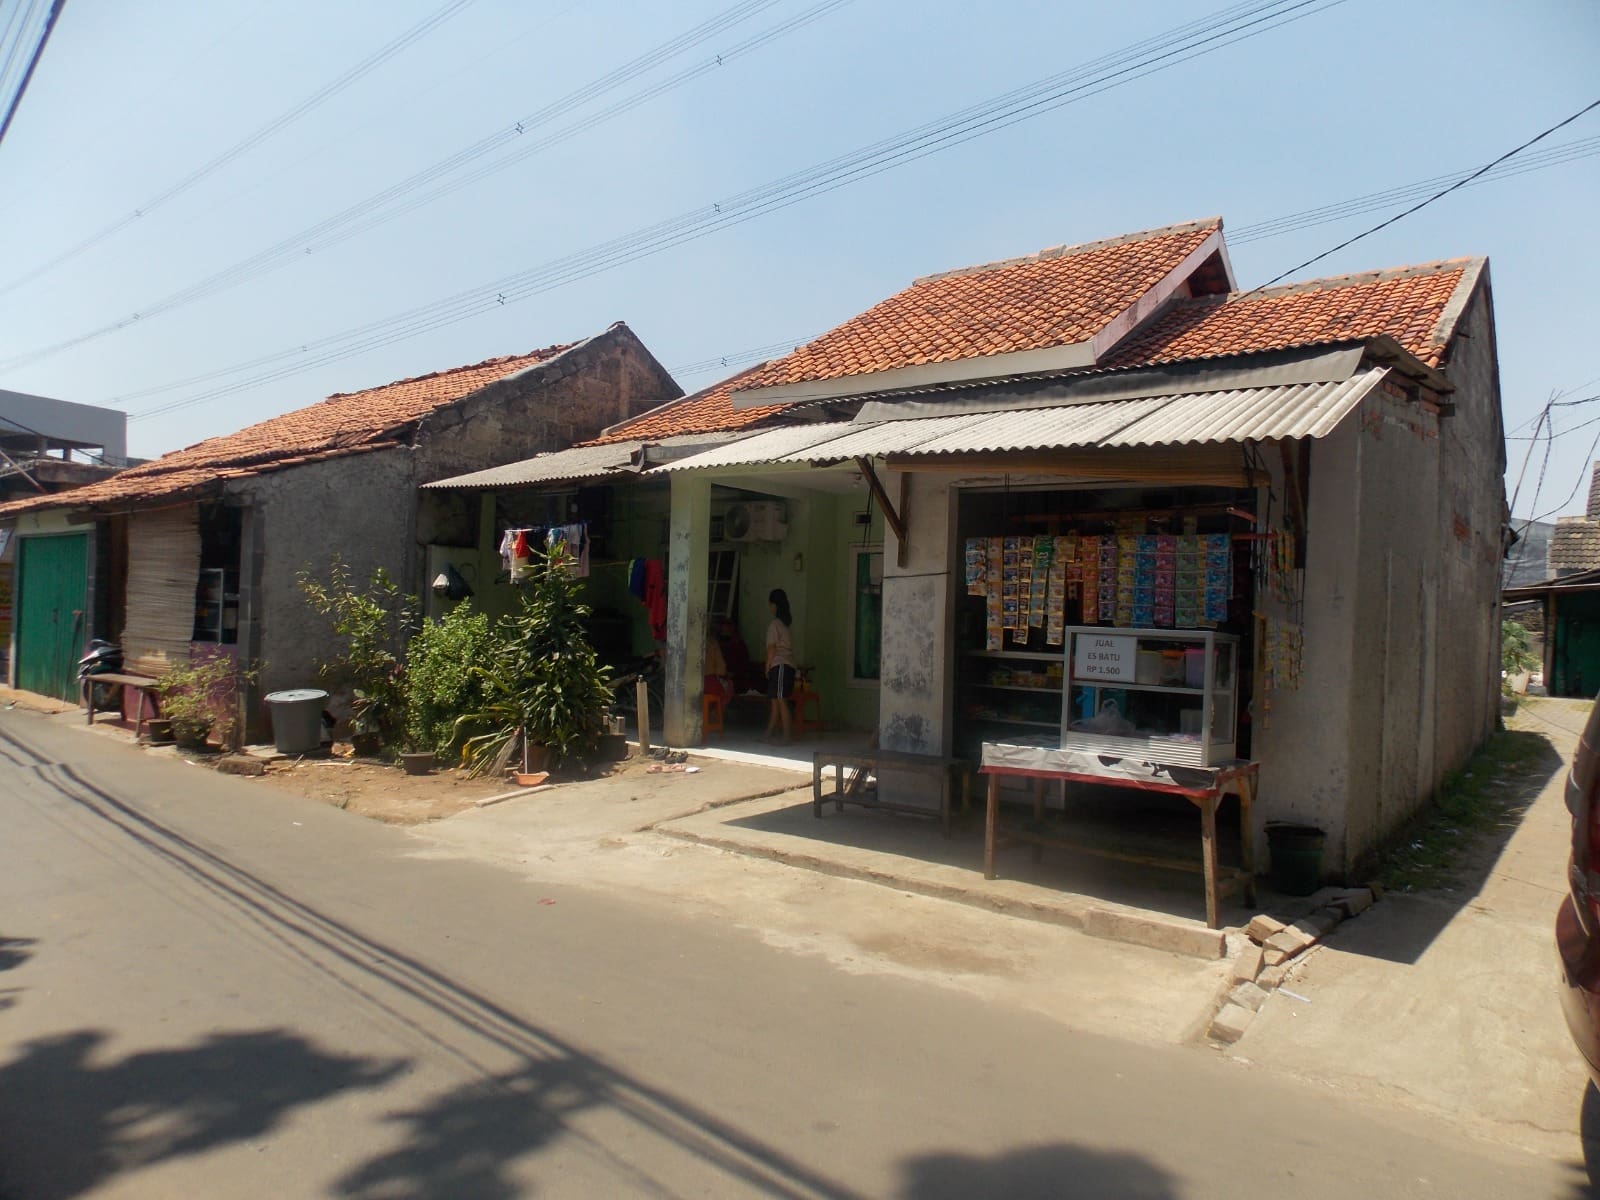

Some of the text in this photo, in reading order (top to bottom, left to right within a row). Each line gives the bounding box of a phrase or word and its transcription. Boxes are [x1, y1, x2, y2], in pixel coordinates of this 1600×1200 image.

[1095, 640, 1116, 648] JUAL
[1087, 652, 1120, 662] ES BATU
[1086, 665, 1120, 675] RP 1.500
